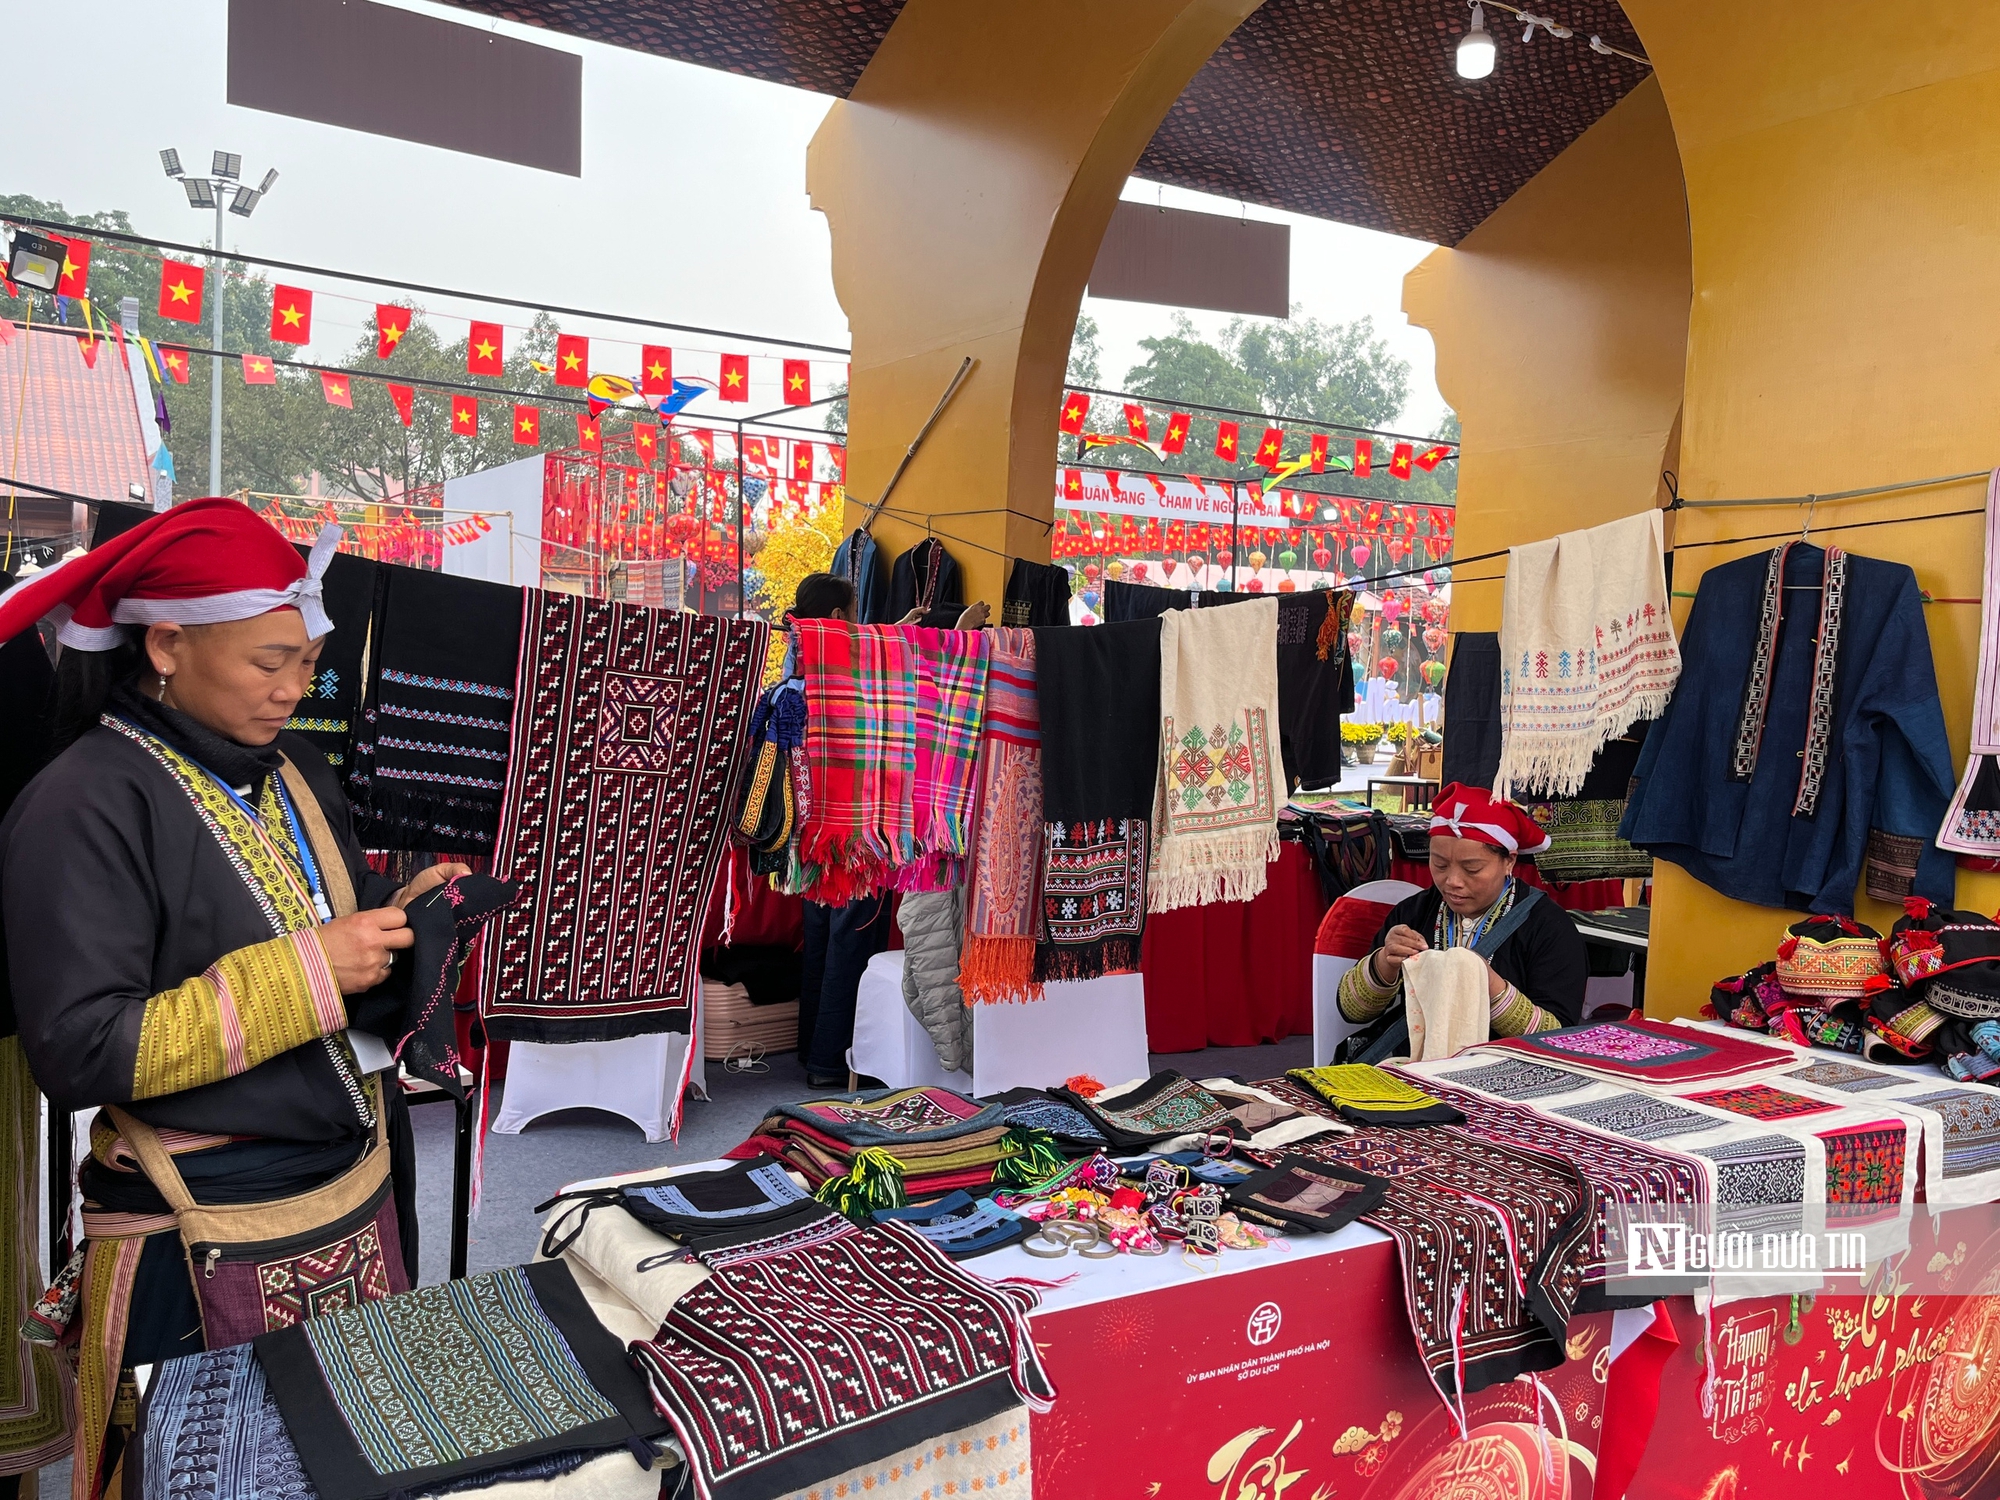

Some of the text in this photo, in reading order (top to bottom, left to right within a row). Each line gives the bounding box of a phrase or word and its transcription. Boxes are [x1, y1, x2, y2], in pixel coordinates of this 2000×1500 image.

[31, 242, 48, 252] LED
[1159, 495, 1192, 511] CHẠM
[1196, 494, 1210, 512] VỀ
[1198, 1369, 1216, 1381] BAN
[1216, 1363, 1240, 1376] NHÂN
[1241, 1358, 1258, 1370] DÂN
[1259, 1352, 1285, 1364] THÀNH
[1286, 1344, 1303, 1358] PHỐ
[1304, 1342, 1315, 1353] HÀ
[1316, 1339, 1331, 1351] NỘI
[1718, 1324, 1770, 1369] Happy
[1237, 1363, 1280, 1381] SỞ DU LỊCH
[1829, 1339, 1887, 1401] hạnh
[1888, 1327, 1943, 1416] phúc
[1721, 1365, 1749, 1424] Tết
[1437, 1436, 1498, 1478] 2026
